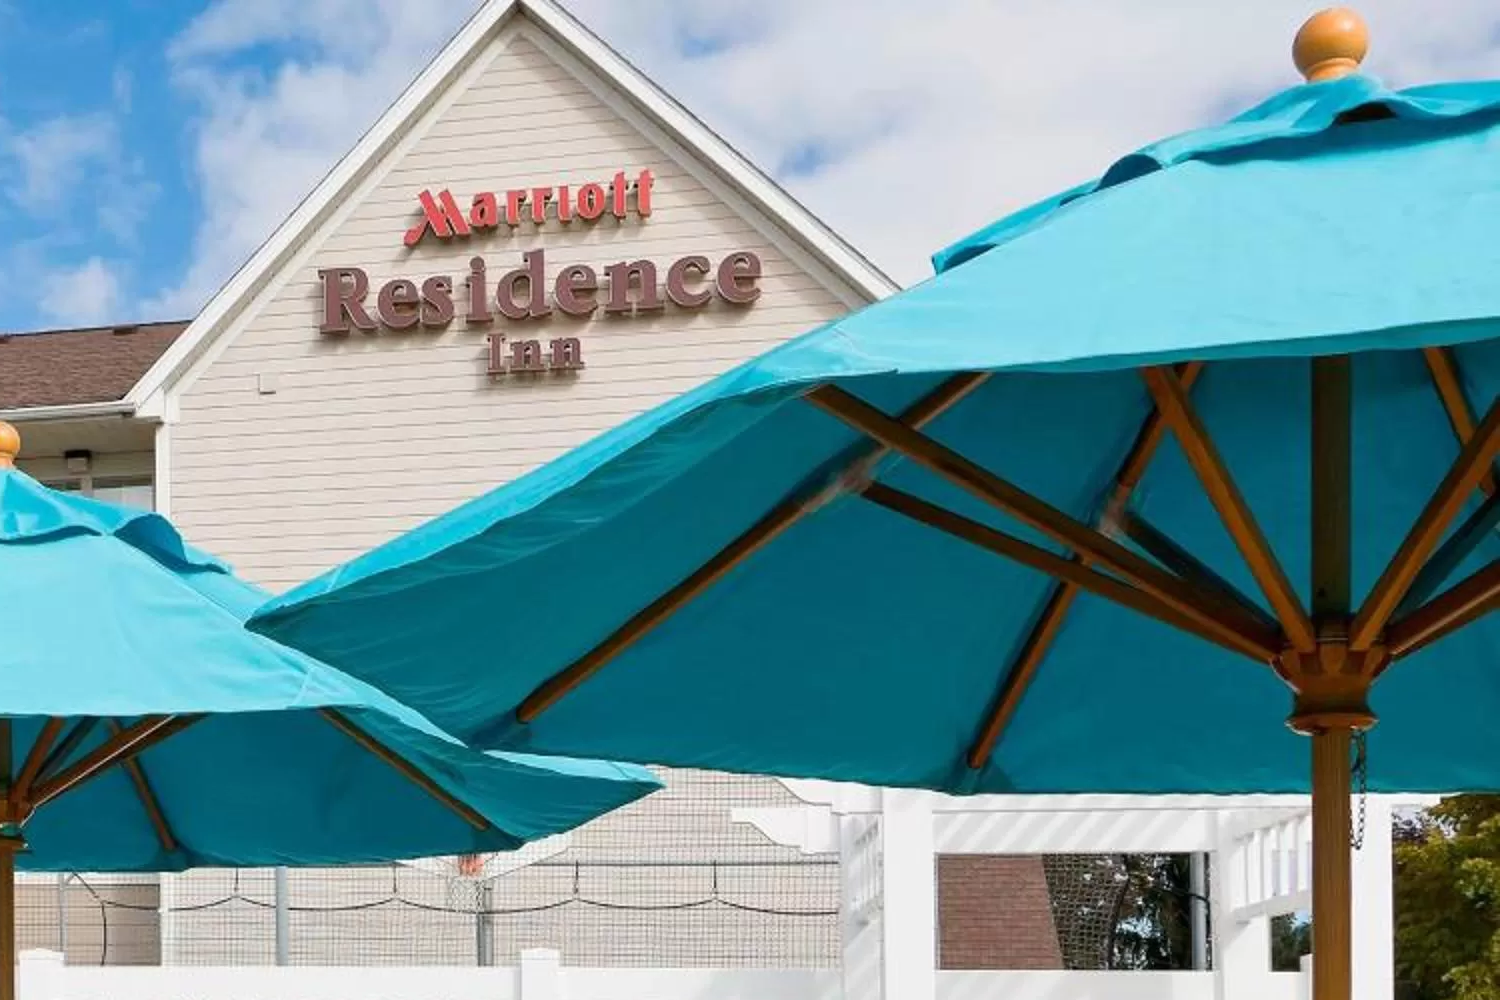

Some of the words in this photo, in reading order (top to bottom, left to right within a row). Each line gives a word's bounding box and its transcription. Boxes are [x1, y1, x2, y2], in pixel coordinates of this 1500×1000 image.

[404, 169, 653, 246] Marriott
[318, 248, 762, 334] Residence
[486, 332, 585, 374] Inn
